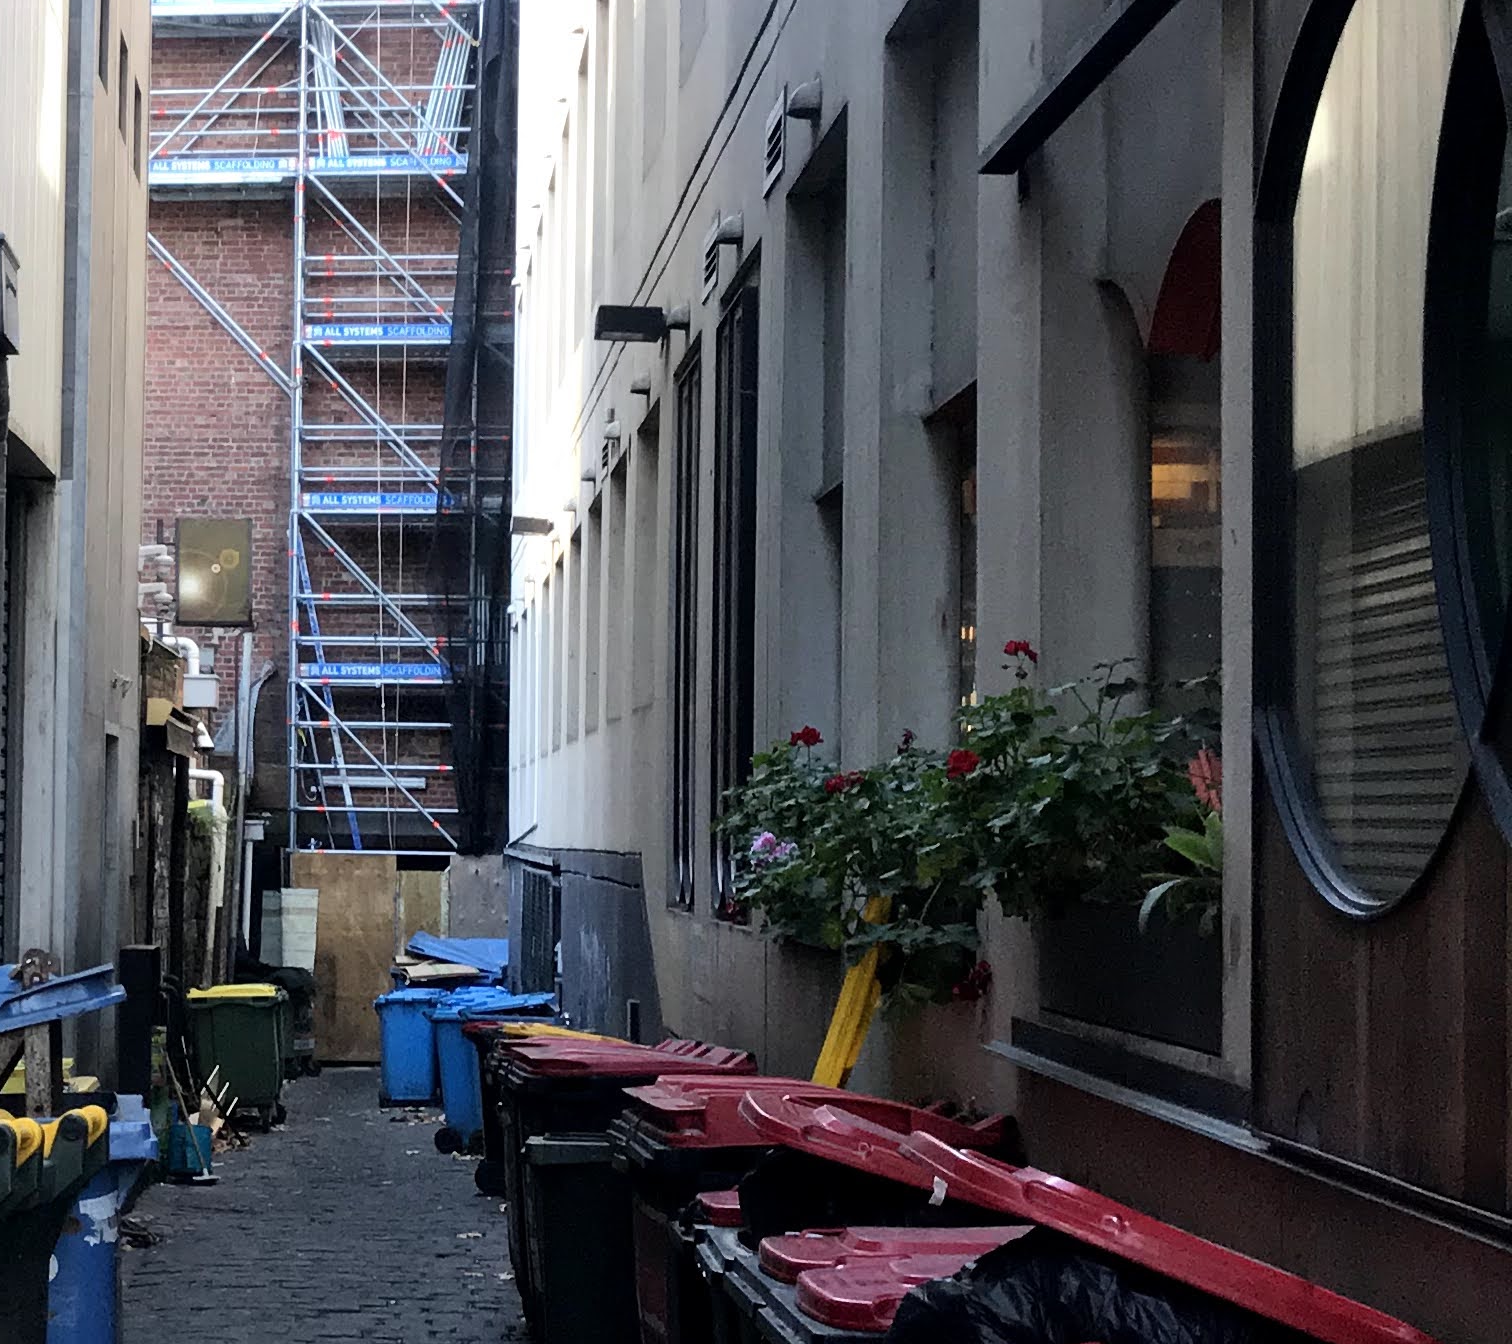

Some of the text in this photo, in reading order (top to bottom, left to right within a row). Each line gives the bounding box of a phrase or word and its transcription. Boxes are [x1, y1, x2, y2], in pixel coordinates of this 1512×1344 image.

[153, 159, 275, 171] ALL SYSTEMS SCAFFOLDING
[328, 158, 345, 168] ALL
[346, 157, 387, 168] SYSTEMS
[324, 325, 450, 337] ALL SYSTEMS SCAFFOLDING
[322, 495, 340, 505] ALL
[341, 495, 381, 505] SYSTEMS
[321, 665, 447, 676] ALL SYSTEMS SCAFFOLDIN
